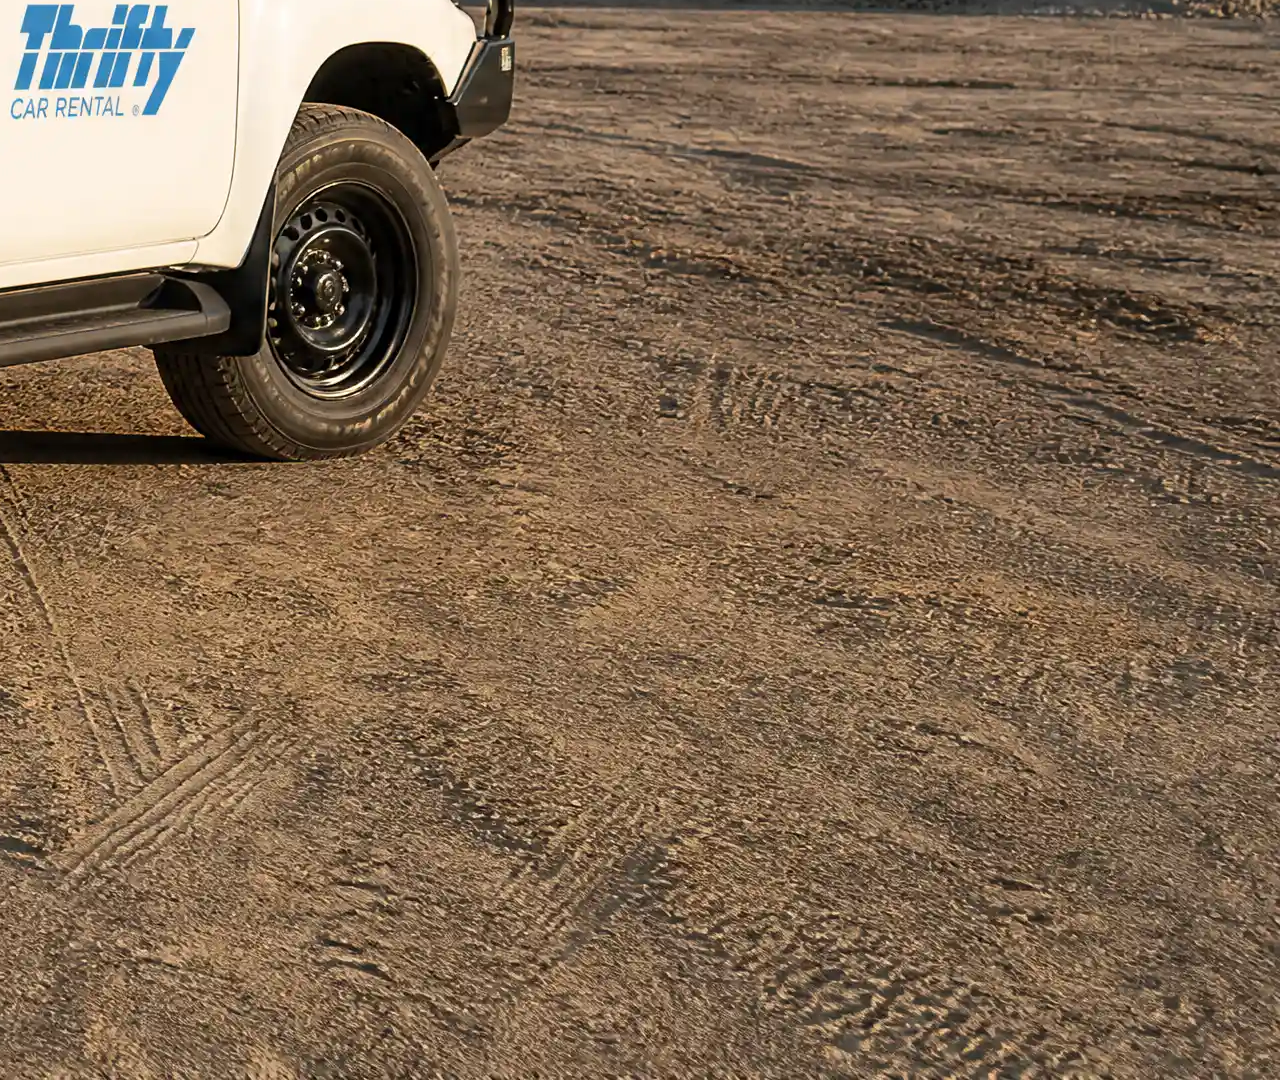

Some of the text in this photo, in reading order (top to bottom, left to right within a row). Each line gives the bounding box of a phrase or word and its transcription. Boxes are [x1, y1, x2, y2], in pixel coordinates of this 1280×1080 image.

[13, 4, 196, 116] Thrifty
[10, 96, 124, 120] CAR RENTAL
